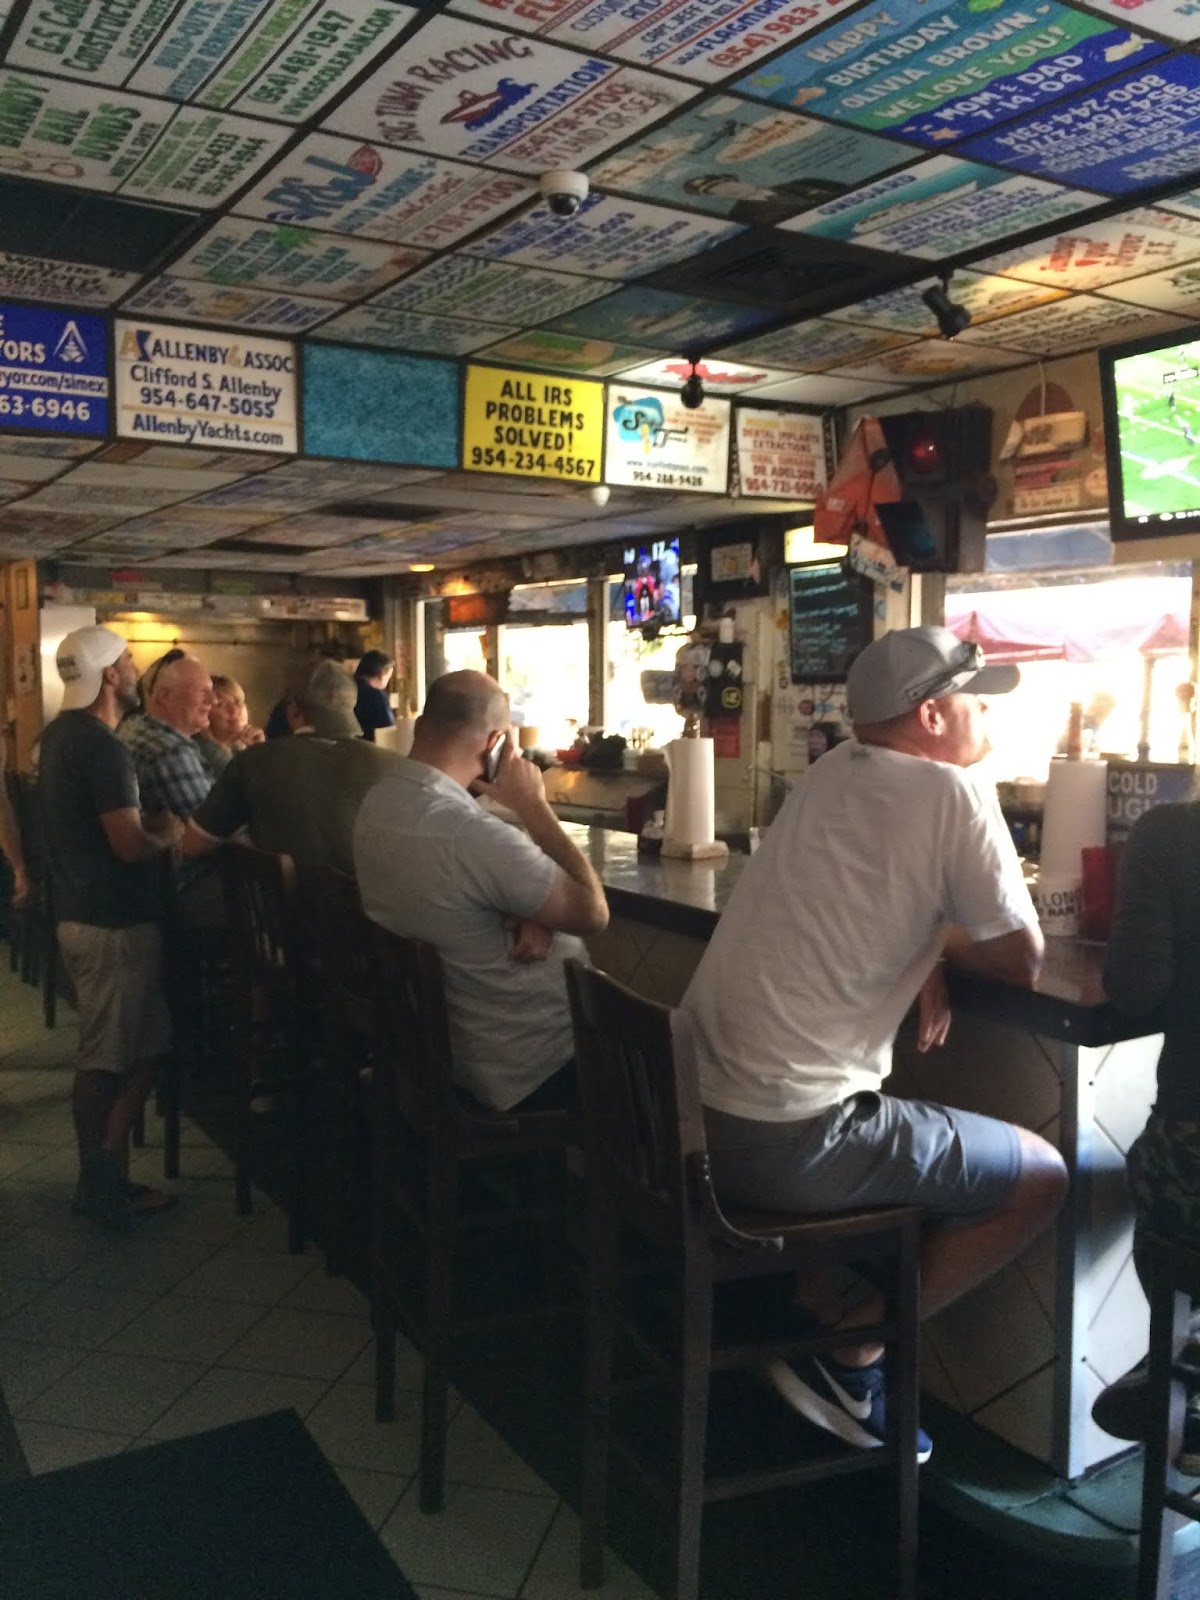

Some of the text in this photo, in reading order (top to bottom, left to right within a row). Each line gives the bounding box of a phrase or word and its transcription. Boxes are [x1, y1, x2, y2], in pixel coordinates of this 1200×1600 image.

[806, 11, 899, 63] HAPPY
[827, 15, 960, 87] BIRTHDAY
[407, 35, 535, 86] RACING
[841, 12, 1037, 109] OLIVIA BROWN
[875, 26, 1073, 119] WE LOVE YOU!
[458, 58, 613, 158] TRANSPORTATION
[935, 91, 1000, 121] MOM
[1016, 55, 1083, 85] DAD
[32, 108, 90, 145] BAIL
[72, 103, 141, 161] BONDS
[151, 338, 230, 365] ALLENBY
[130, 364, 197, 389] Clifford
[220, 375, 282, 405] Allenby
[140, 387, 275, 418] 954-647-5055
[500, 380, 572, 406] ALL IRS
[486, 401, 584, 431] PROBLEMS
[494, 425, 573, 453] SOLVED!
[471, 447, 595, 478] 954-234-4567
[1108, 771, 1158, 794] COLD
